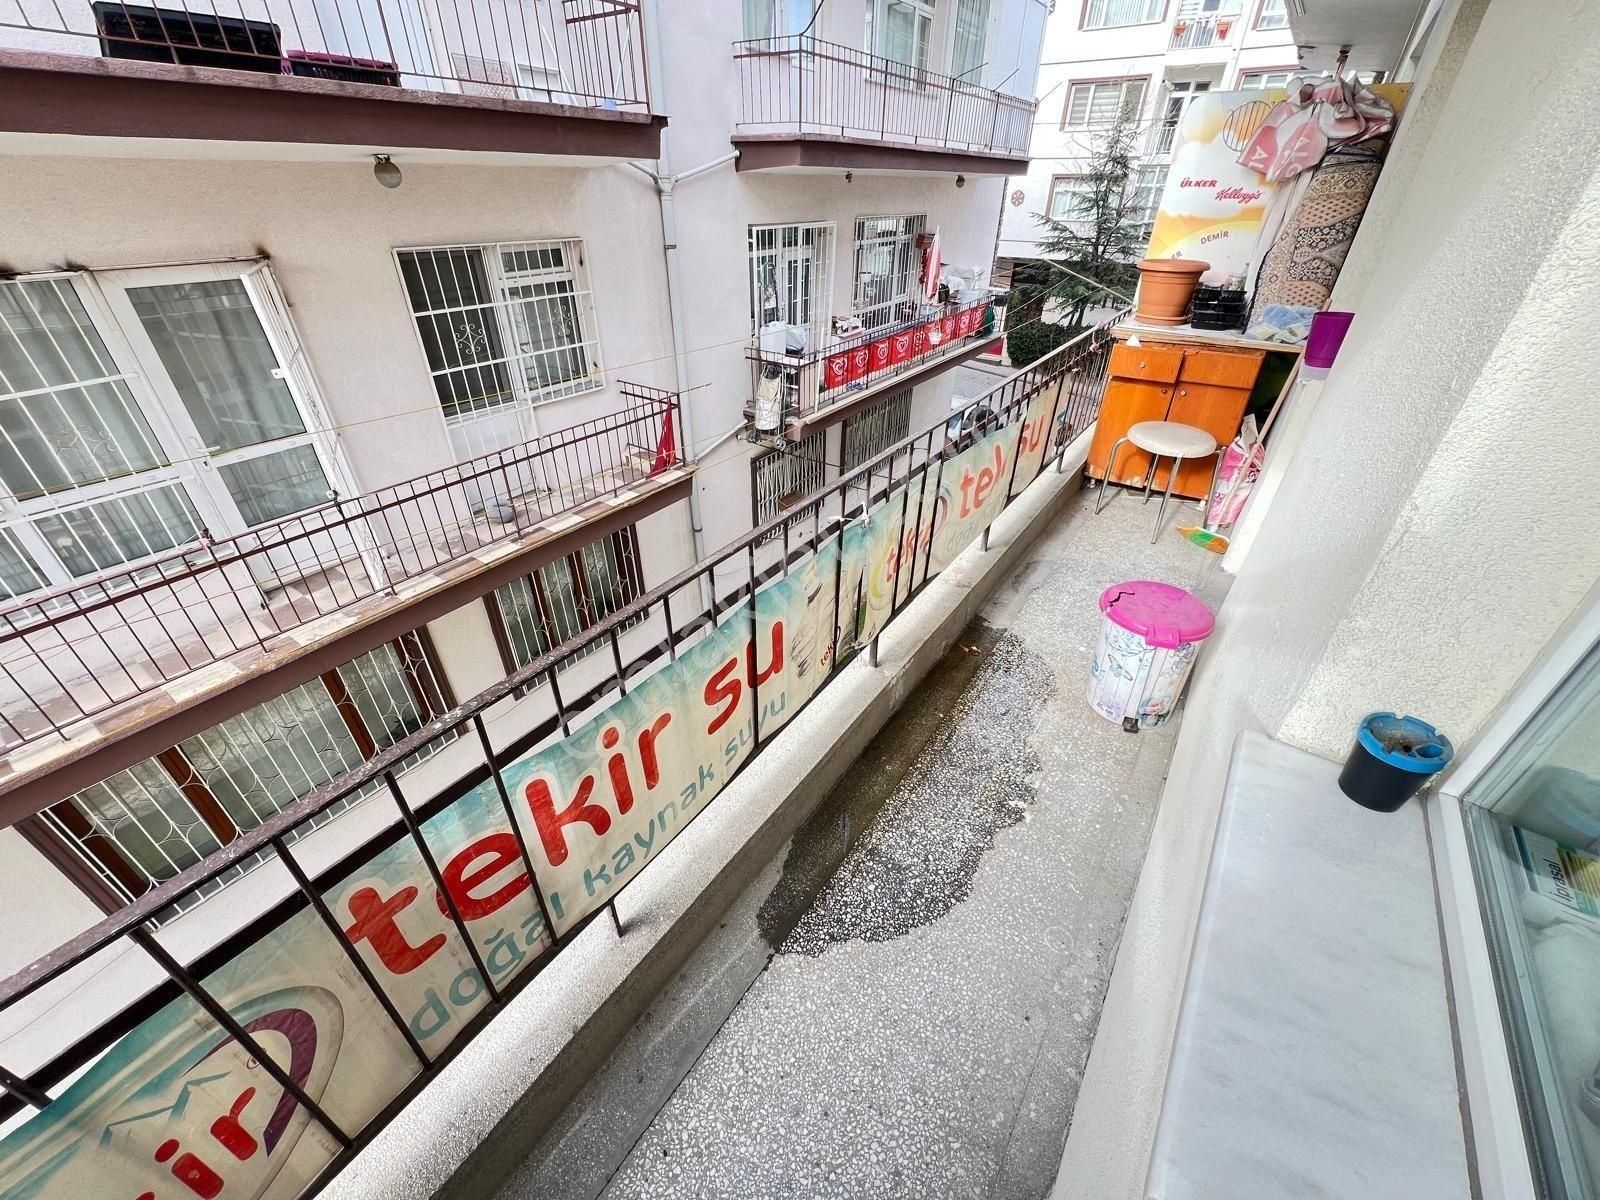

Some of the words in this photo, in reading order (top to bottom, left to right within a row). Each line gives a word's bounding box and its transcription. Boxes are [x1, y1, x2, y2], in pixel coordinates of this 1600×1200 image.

[1180, 177, 1217, 188] ÜLKER
[1215, 187, 1262, 204] Kellogg's
[1200, 231, 1230, 244] DEMİR
[344, 711, 671, 975] tekir
[704, 620, 784, 735] su
[409, 891, 565, 1040] doğal
[583, 762, 715, 897] kaynak
[725, 692, 786, 767] suyu
